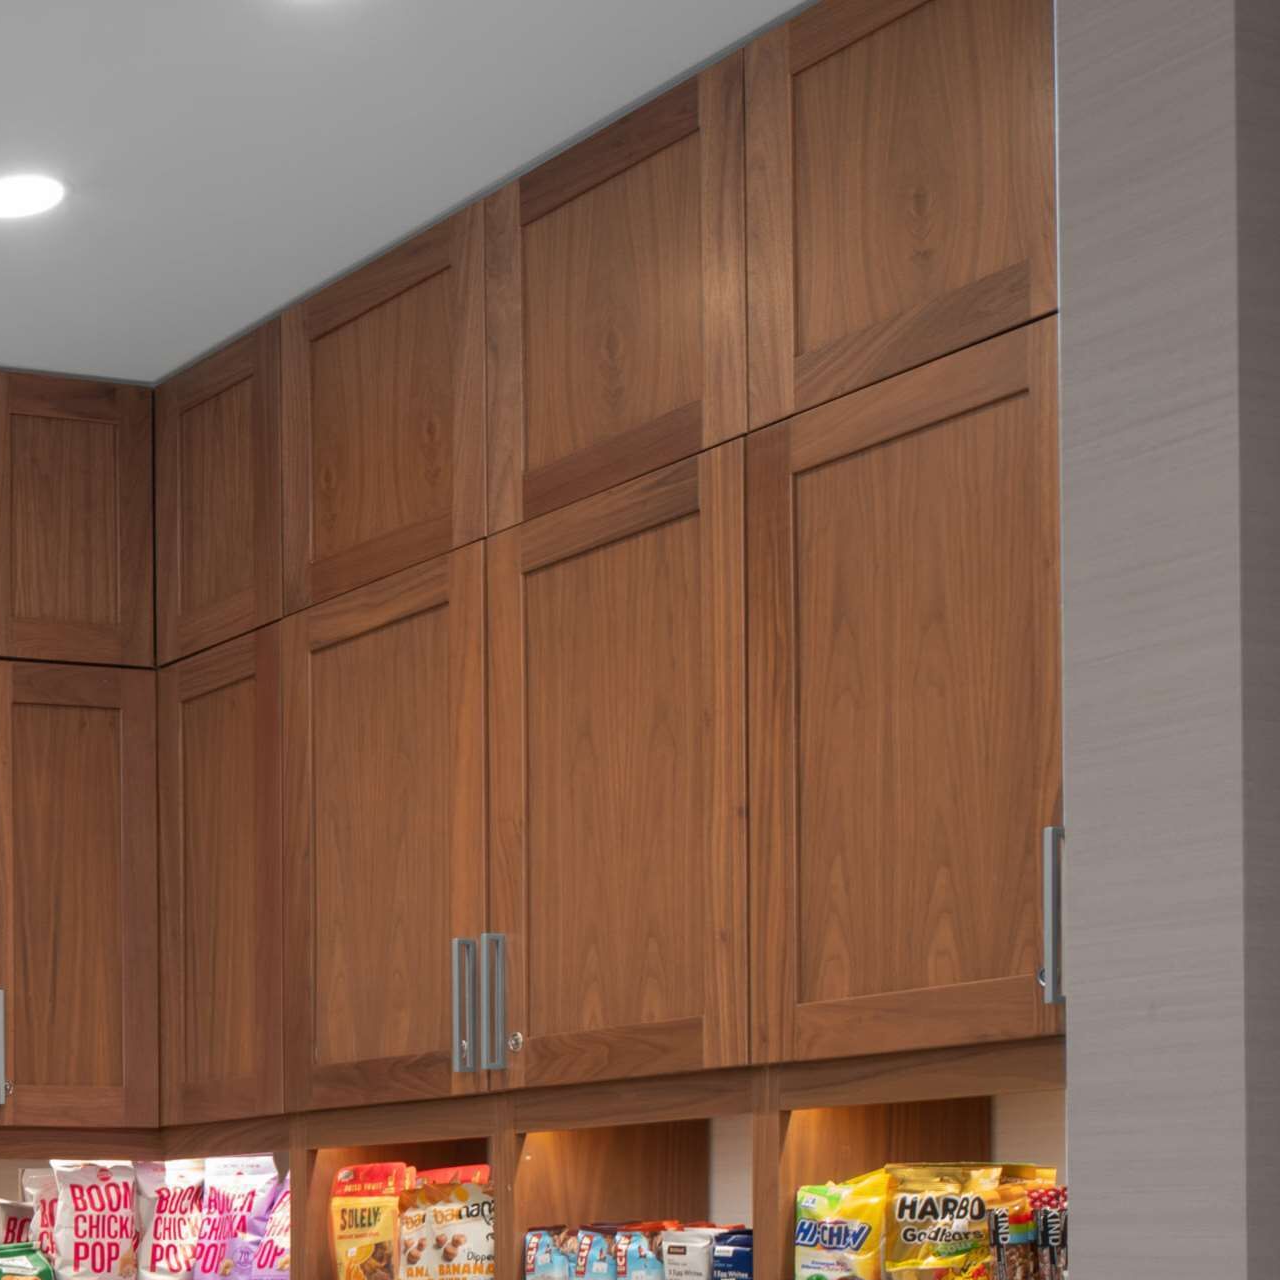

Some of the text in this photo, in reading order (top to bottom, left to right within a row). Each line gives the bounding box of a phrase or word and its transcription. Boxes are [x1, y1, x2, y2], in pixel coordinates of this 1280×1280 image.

[340, 1207, 381, 1231] SOLELY
[897, 1195, 987, 1222] HARBO
[995, 1208, 1010, 1244] KIND
[1047, 1207, 1062, 1246] KIND
[73, 1241, 120, 1273] POP
[195, 1243, 228, 1274] POP
[467, 1250, 495, 1263] Dippe
